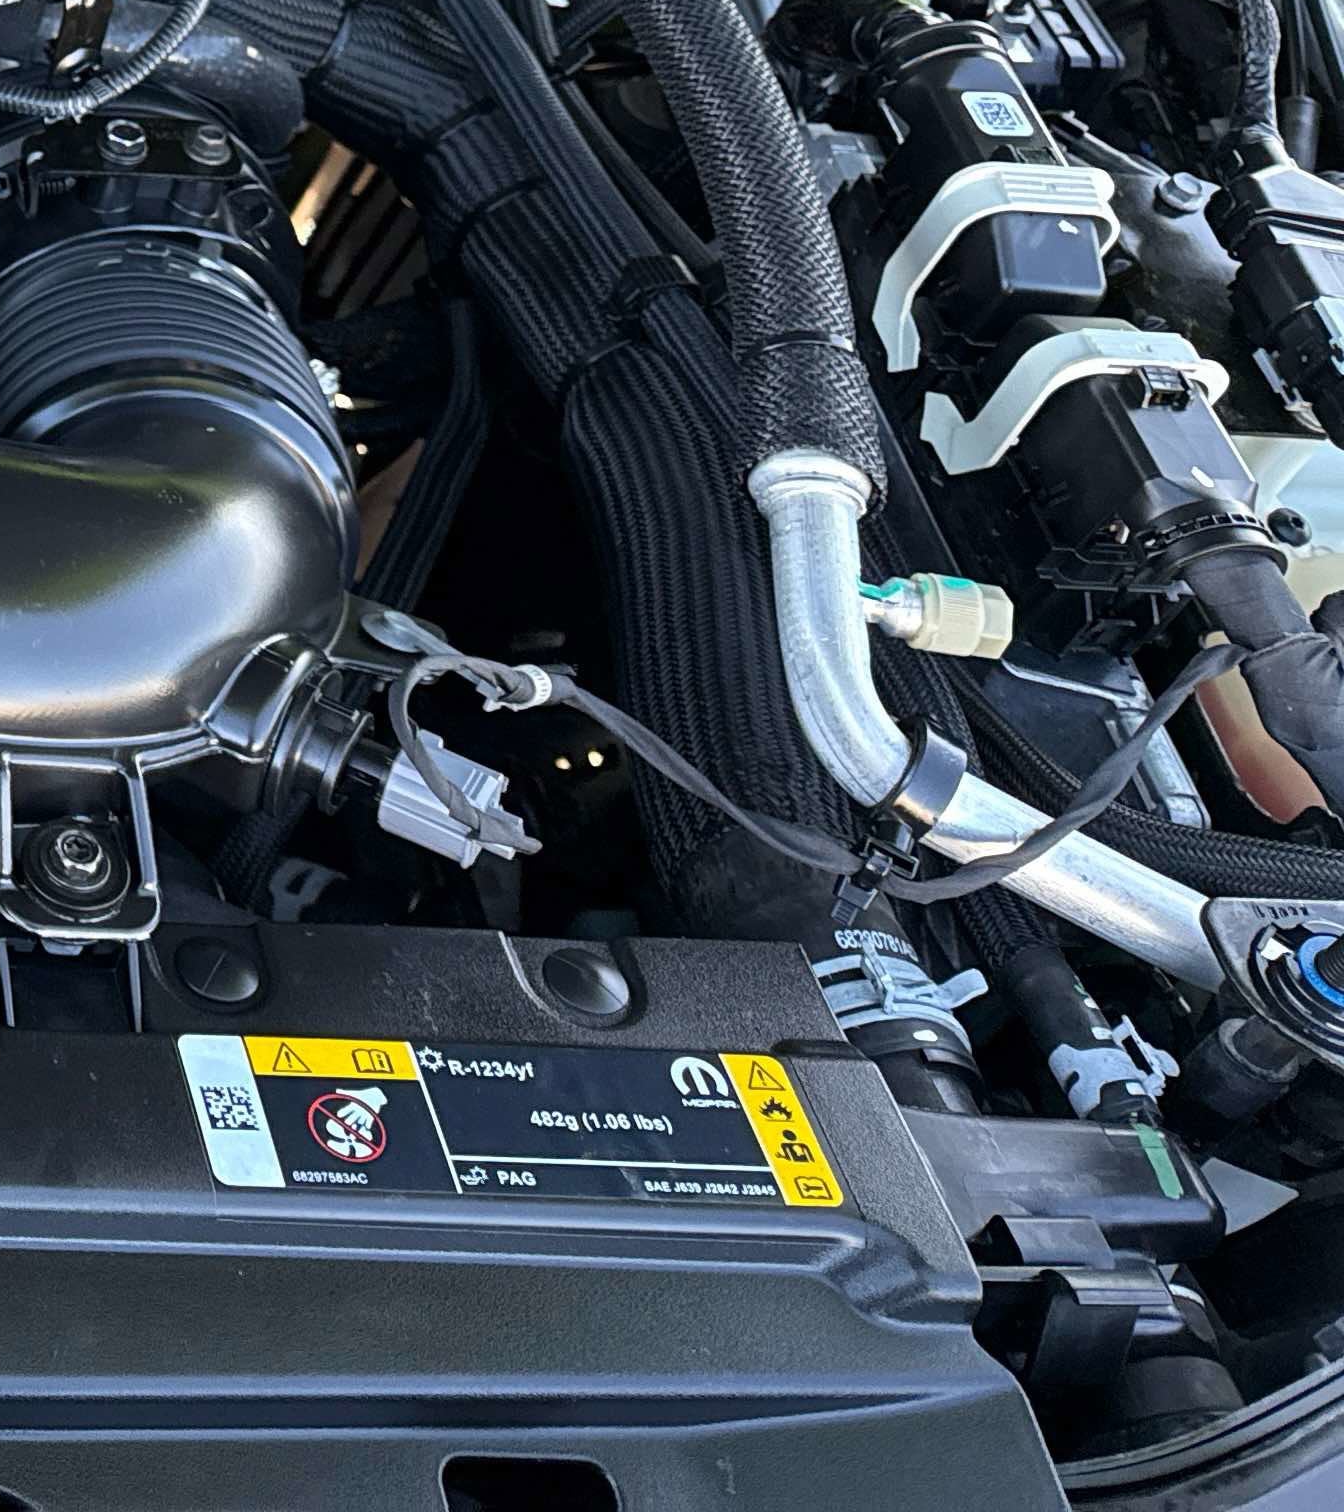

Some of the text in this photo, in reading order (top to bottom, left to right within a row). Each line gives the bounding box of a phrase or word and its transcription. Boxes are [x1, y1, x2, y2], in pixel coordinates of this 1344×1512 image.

[447, 1059, 535, 1082] R-1234yf
[529, 1110, 673, 1136] 482g (1.06 lbs)
[496, 1170, 537, 1187] PAG
[644, 1180, 672, 1193] SAE
